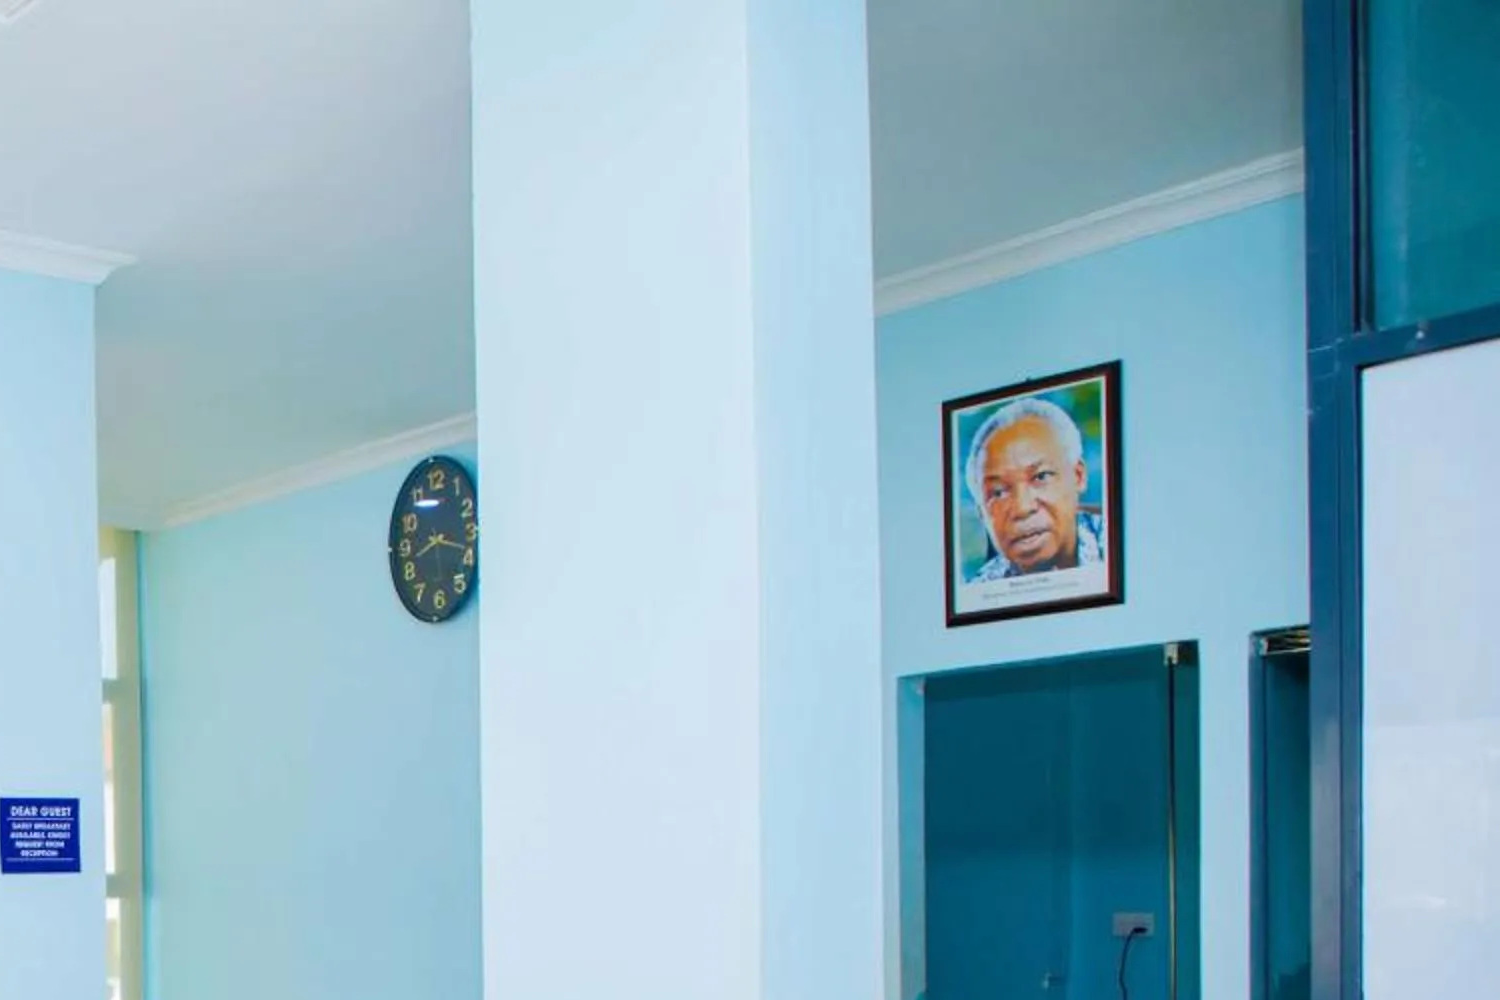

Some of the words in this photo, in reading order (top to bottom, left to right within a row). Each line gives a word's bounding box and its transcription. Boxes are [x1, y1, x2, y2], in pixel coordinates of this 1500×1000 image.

[427, 468, 445, 490] 12
[453, 477, 460, 496] 1
[461, 498, 473, 518] 2
[402, 513, 418, 533] 10
[465, 523, 477, 541] 3
[399, 539, 411, 558] 9
[462, 549, 474, 567] 4
[404, 562, 416, 580] 8
[414, 583, 425, 602] 7
[453, 573, 466, 593] 5
[433, 590, 446, 610] 6
[11, 805, 38, 817] DEAR
